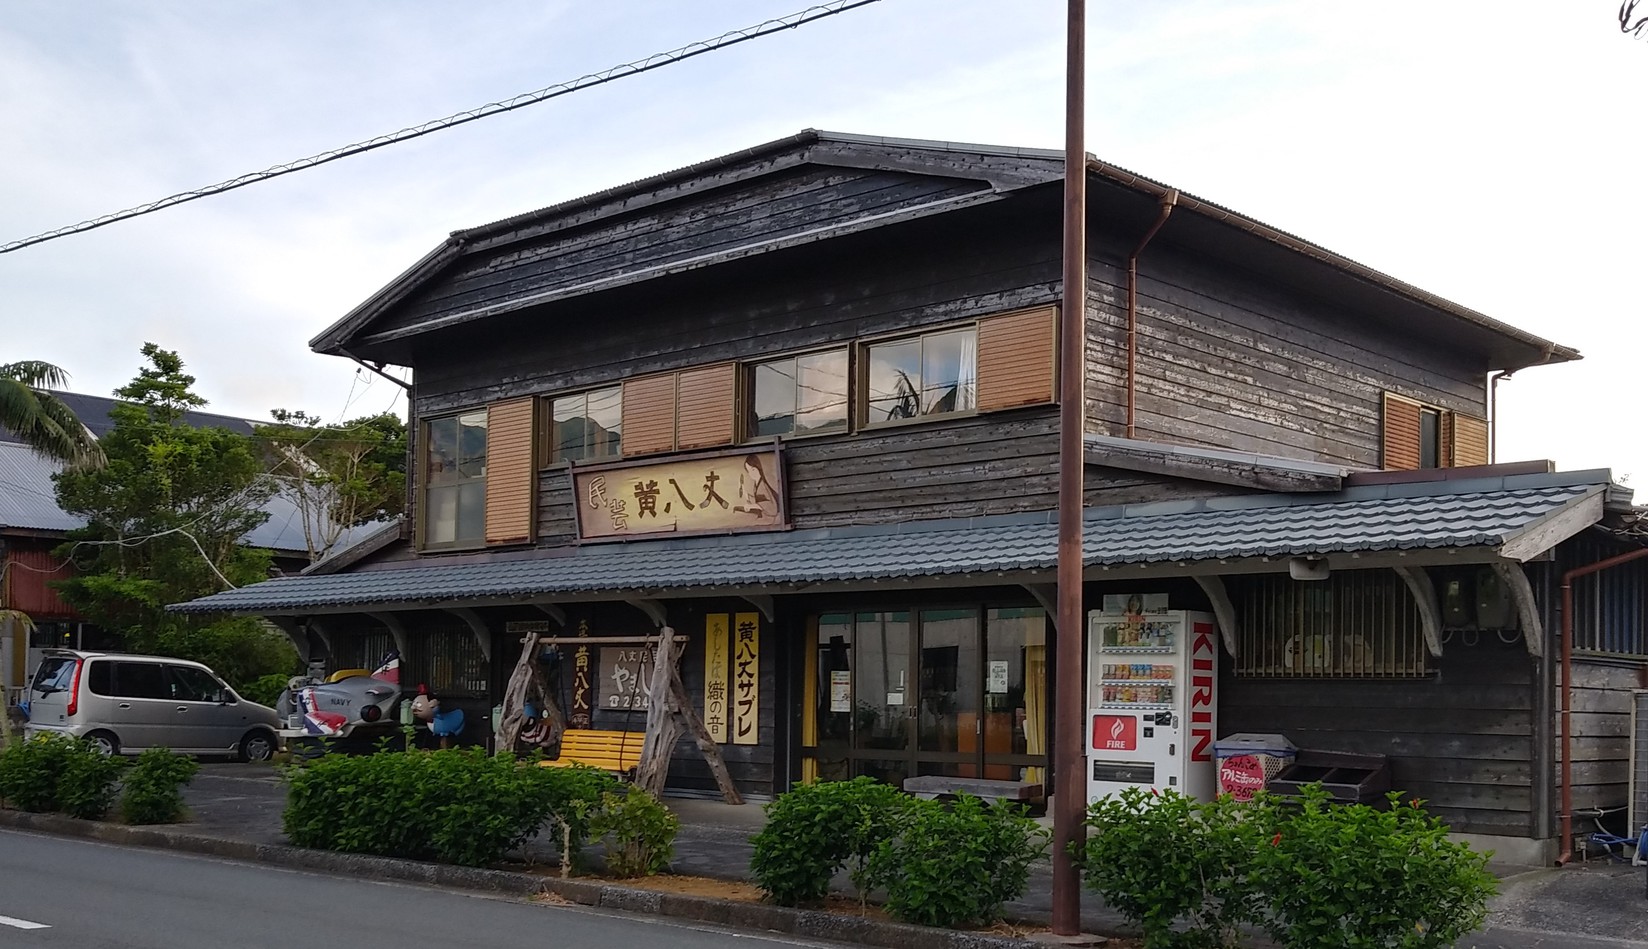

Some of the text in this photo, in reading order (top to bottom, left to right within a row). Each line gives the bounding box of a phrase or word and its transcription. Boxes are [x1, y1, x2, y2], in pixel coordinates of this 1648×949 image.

[588, 470, 730, 530] 民芸 黄八丈
[331, 698, 352, 707] NAVY
[574, 645, 590, 710] 黄八丈
[736, 620, 756, 737] 黄八丈サブレ
[1191, 622, 1214, 762] KIRIN
[1106, 740, 1126, 749] FIRE
[1221, 768, 1263, 785] アルミ缶のみ
